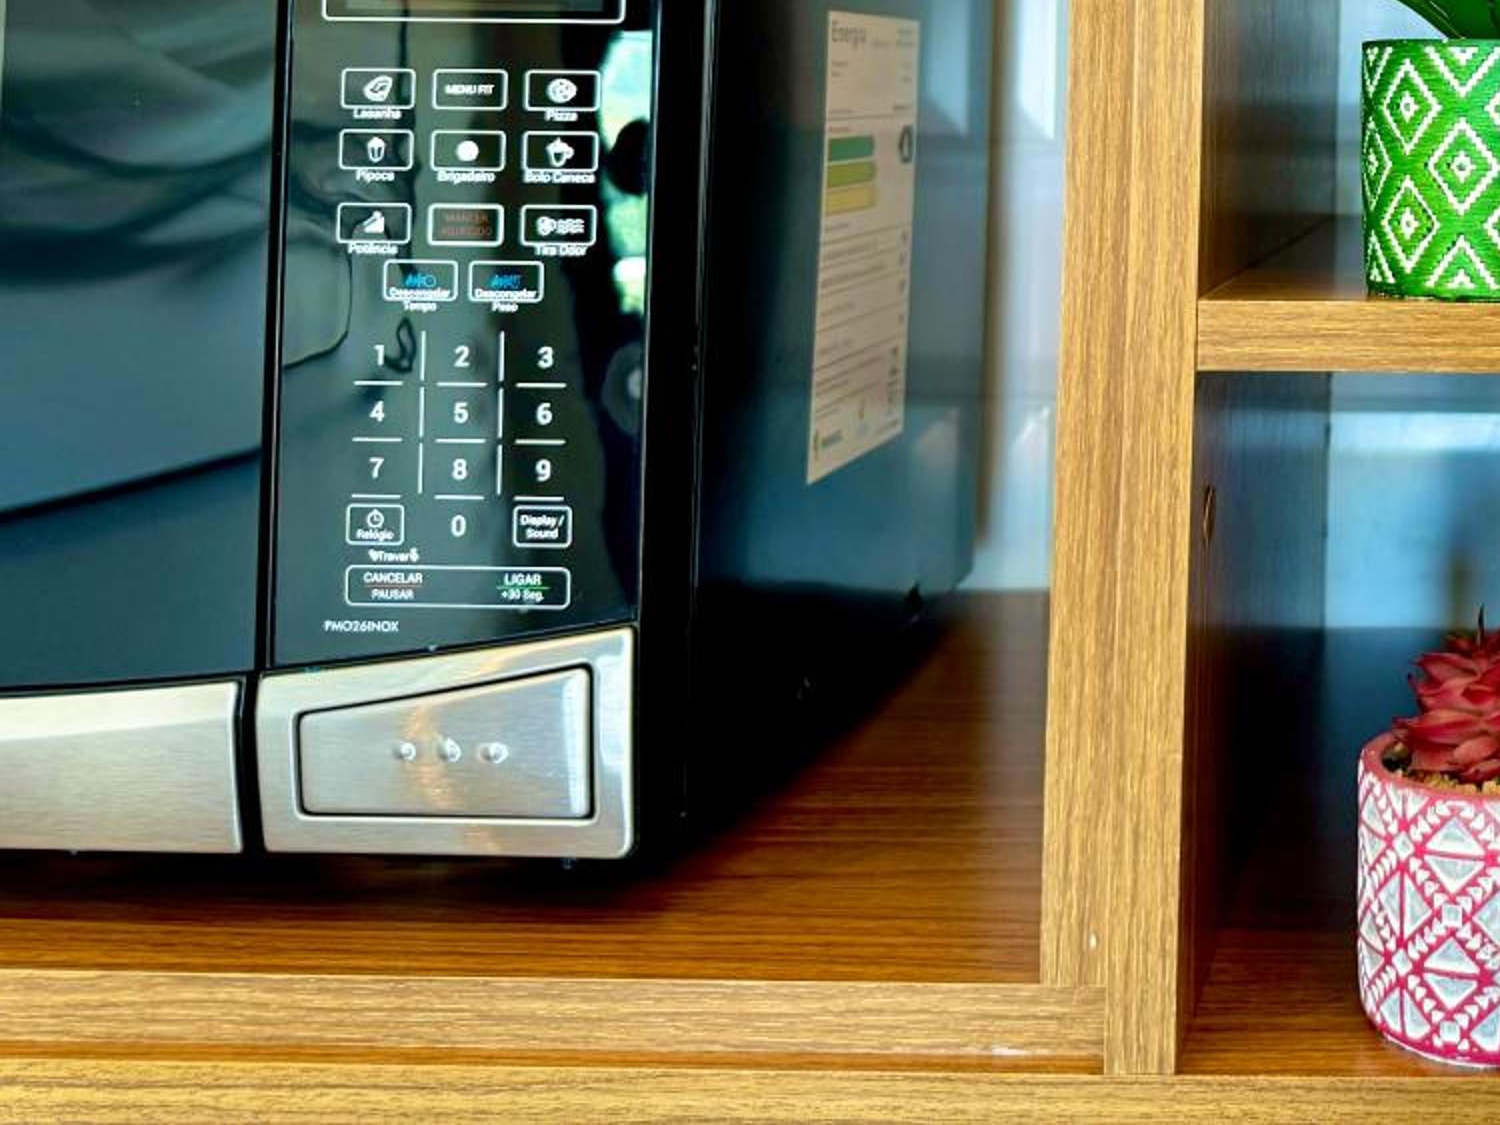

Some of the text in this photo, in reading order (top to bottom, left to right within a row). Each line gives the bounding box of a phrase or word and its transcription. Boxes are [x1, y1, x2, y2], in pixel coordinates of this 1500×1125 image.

[445, 84, 494, 95] MENU FIT
[354, 109, 401, 120] Lasanha
[545, 110, 577, 121] Pizza
[356, 170, 394, 183] Pipoca
[374, 344, 385, 366] 1
[454, 346, 470, 367] 2
[537, 346, 554, 368] 3
[369, 401, 385, 422] 4
[454, 402, 469, 423] 5
[536, 403, 553, 425] 6
[369, 458, 385, 479] 7
[452, 458, 467, 480] 8
[535, 459, 551, 481] 9
[451, 514, 467, 537] 0
[526, 528, 559, 539] Sound
[363, 571, 423, 583] CANCELAR
[504, 573, 542, 586] LIGAR
[371, 588, 414, 600] PAUSAR
